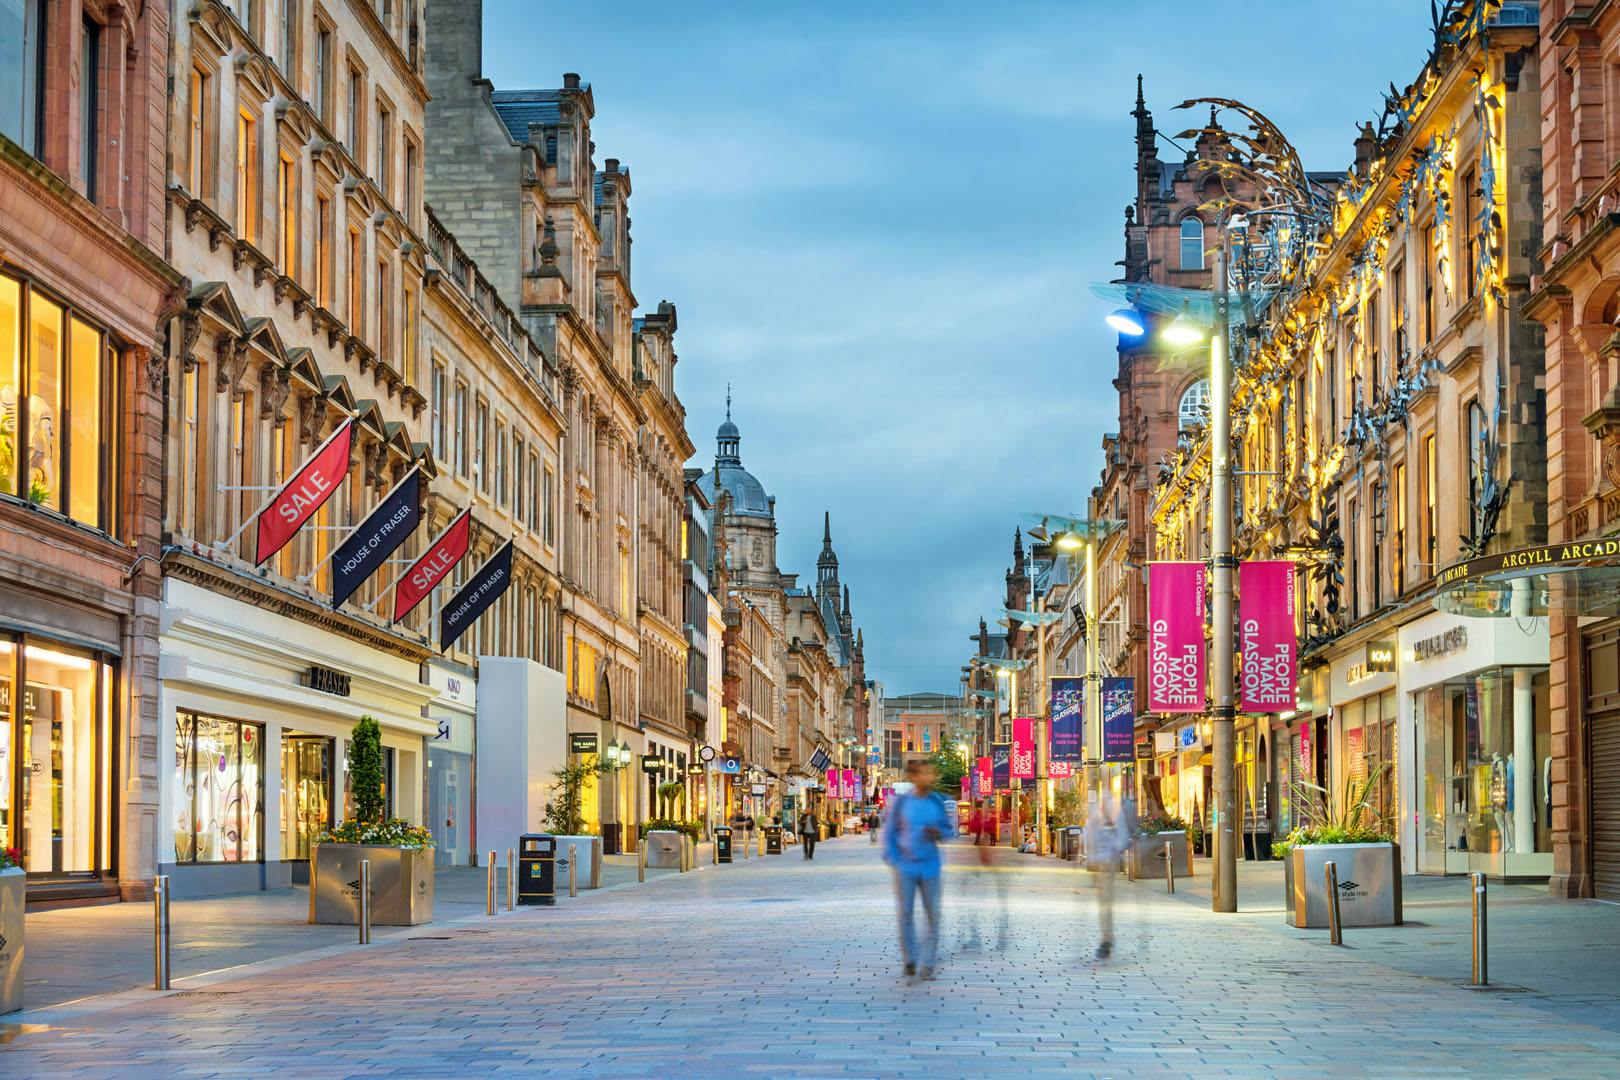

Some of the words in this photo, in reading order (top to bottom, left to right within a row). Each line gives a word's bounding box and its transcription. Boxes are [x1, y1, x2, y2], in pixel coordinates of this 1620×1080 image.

[279, 470, 331, 523] SALE
[340, 546, 370, 576] HOUSE
[368, 533, 382, 549] OF
[380, 505, 411, 536] FRASER
[1502, 550, 1552, 568] ARGYLL
[412, 548, 454, 590] SALE
[448, 600, 471, 626] HOUSE
[469, 590, 482, 606] OF
[480, 568, 505, 596] FRASER
[1153, 620, 1168, 704] GLASGOW
[1168, 657, 1182, 704] MAKE
[1184, 644, 1198, 704] PEOPLE
[1244, 620, 1260, 704] GLASGOW
[1260, 657, 1274, 704] MAKE
[1274, 644, 1290, 704] PEOPLE
[1371, 650, 1392, 662] KM
[1054, 702, 1079, 722] GLASGOW
[1105, 702, 1131, 722] GLASGOW
